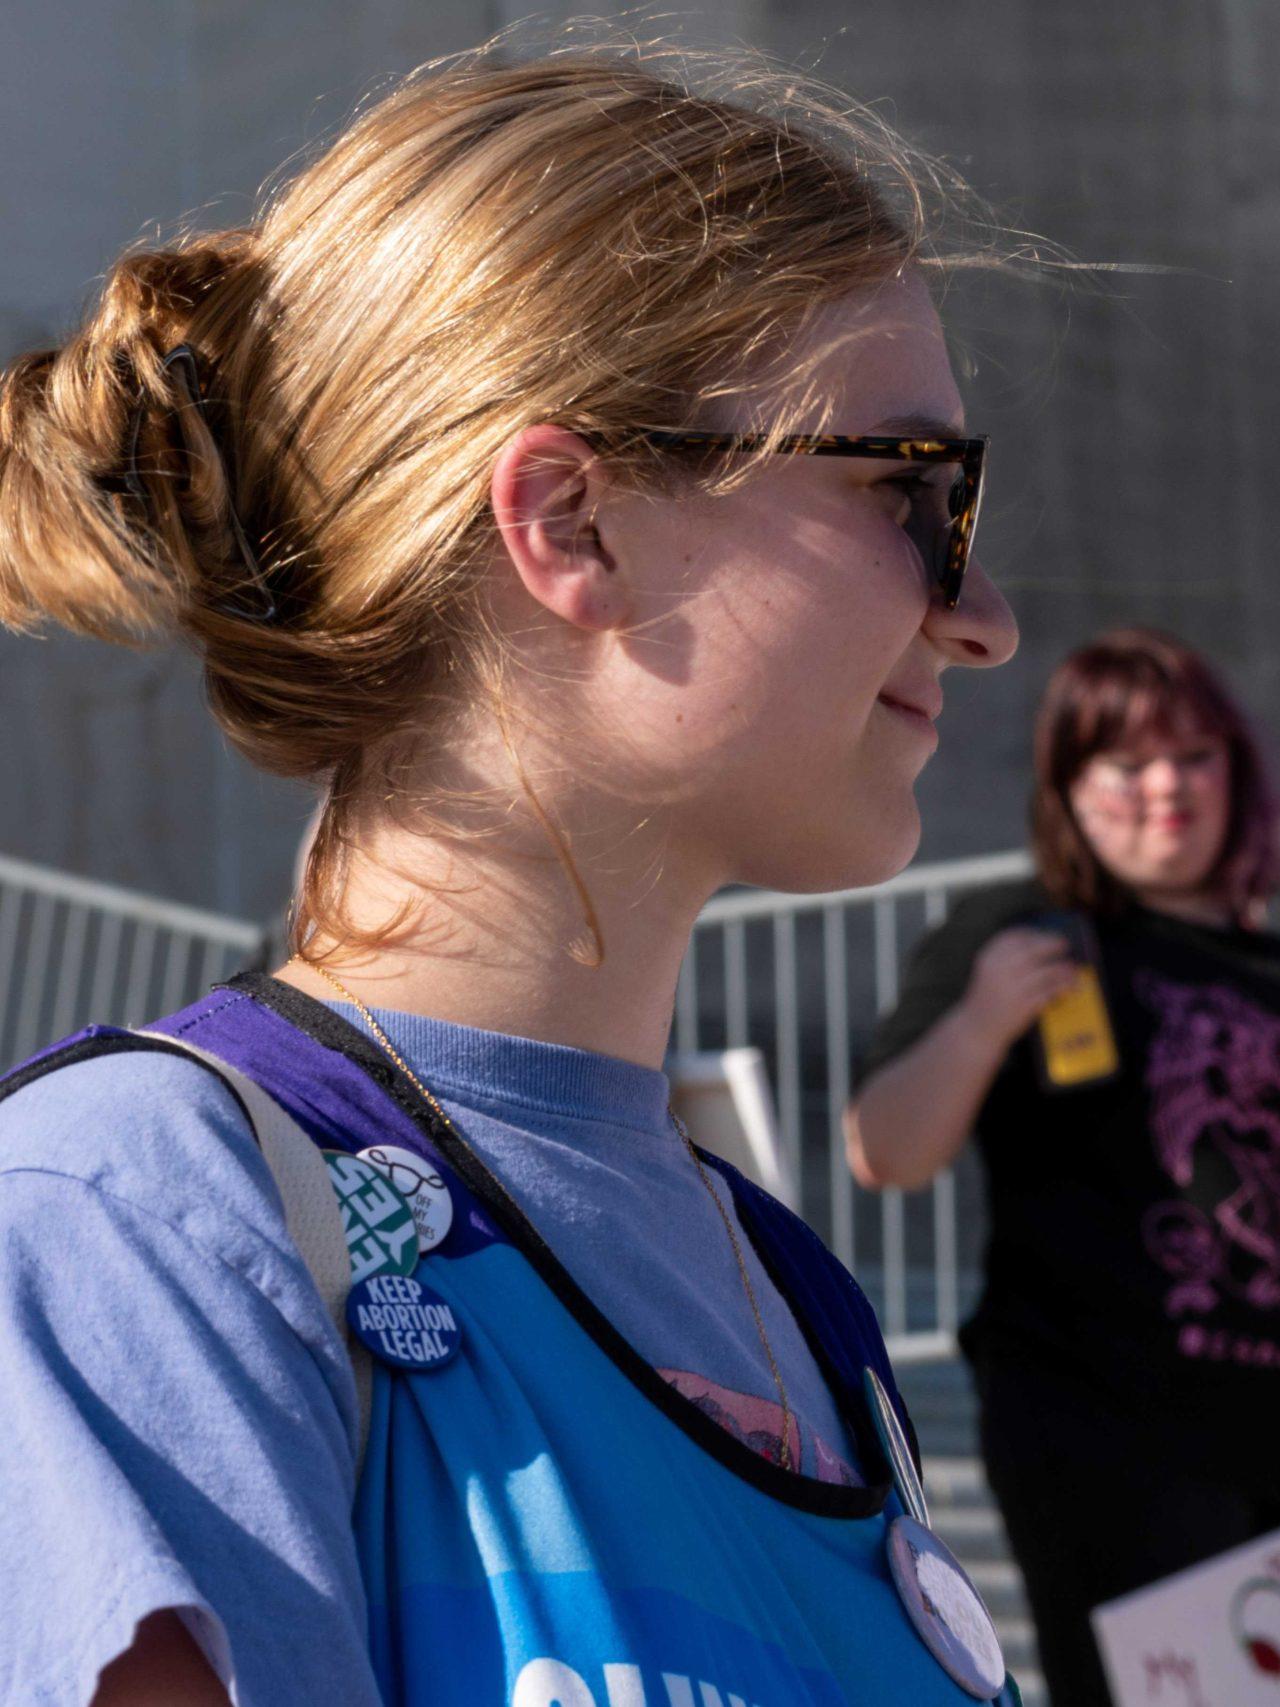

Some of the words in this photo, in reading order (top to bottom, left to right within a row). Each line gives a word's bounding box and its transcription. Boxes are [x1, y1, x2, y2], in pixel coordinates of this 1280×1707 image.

[326, 1155, 417, 1267] YES
[412, 1207, 428, 1222] MY
[416, 1193, 433, 1209] OFF
[365, 1275, 423, 1304] KEEP
[357, 1304, 457, 1332] ABORTION
[379, 1330, 450, 1362] LEGAL
